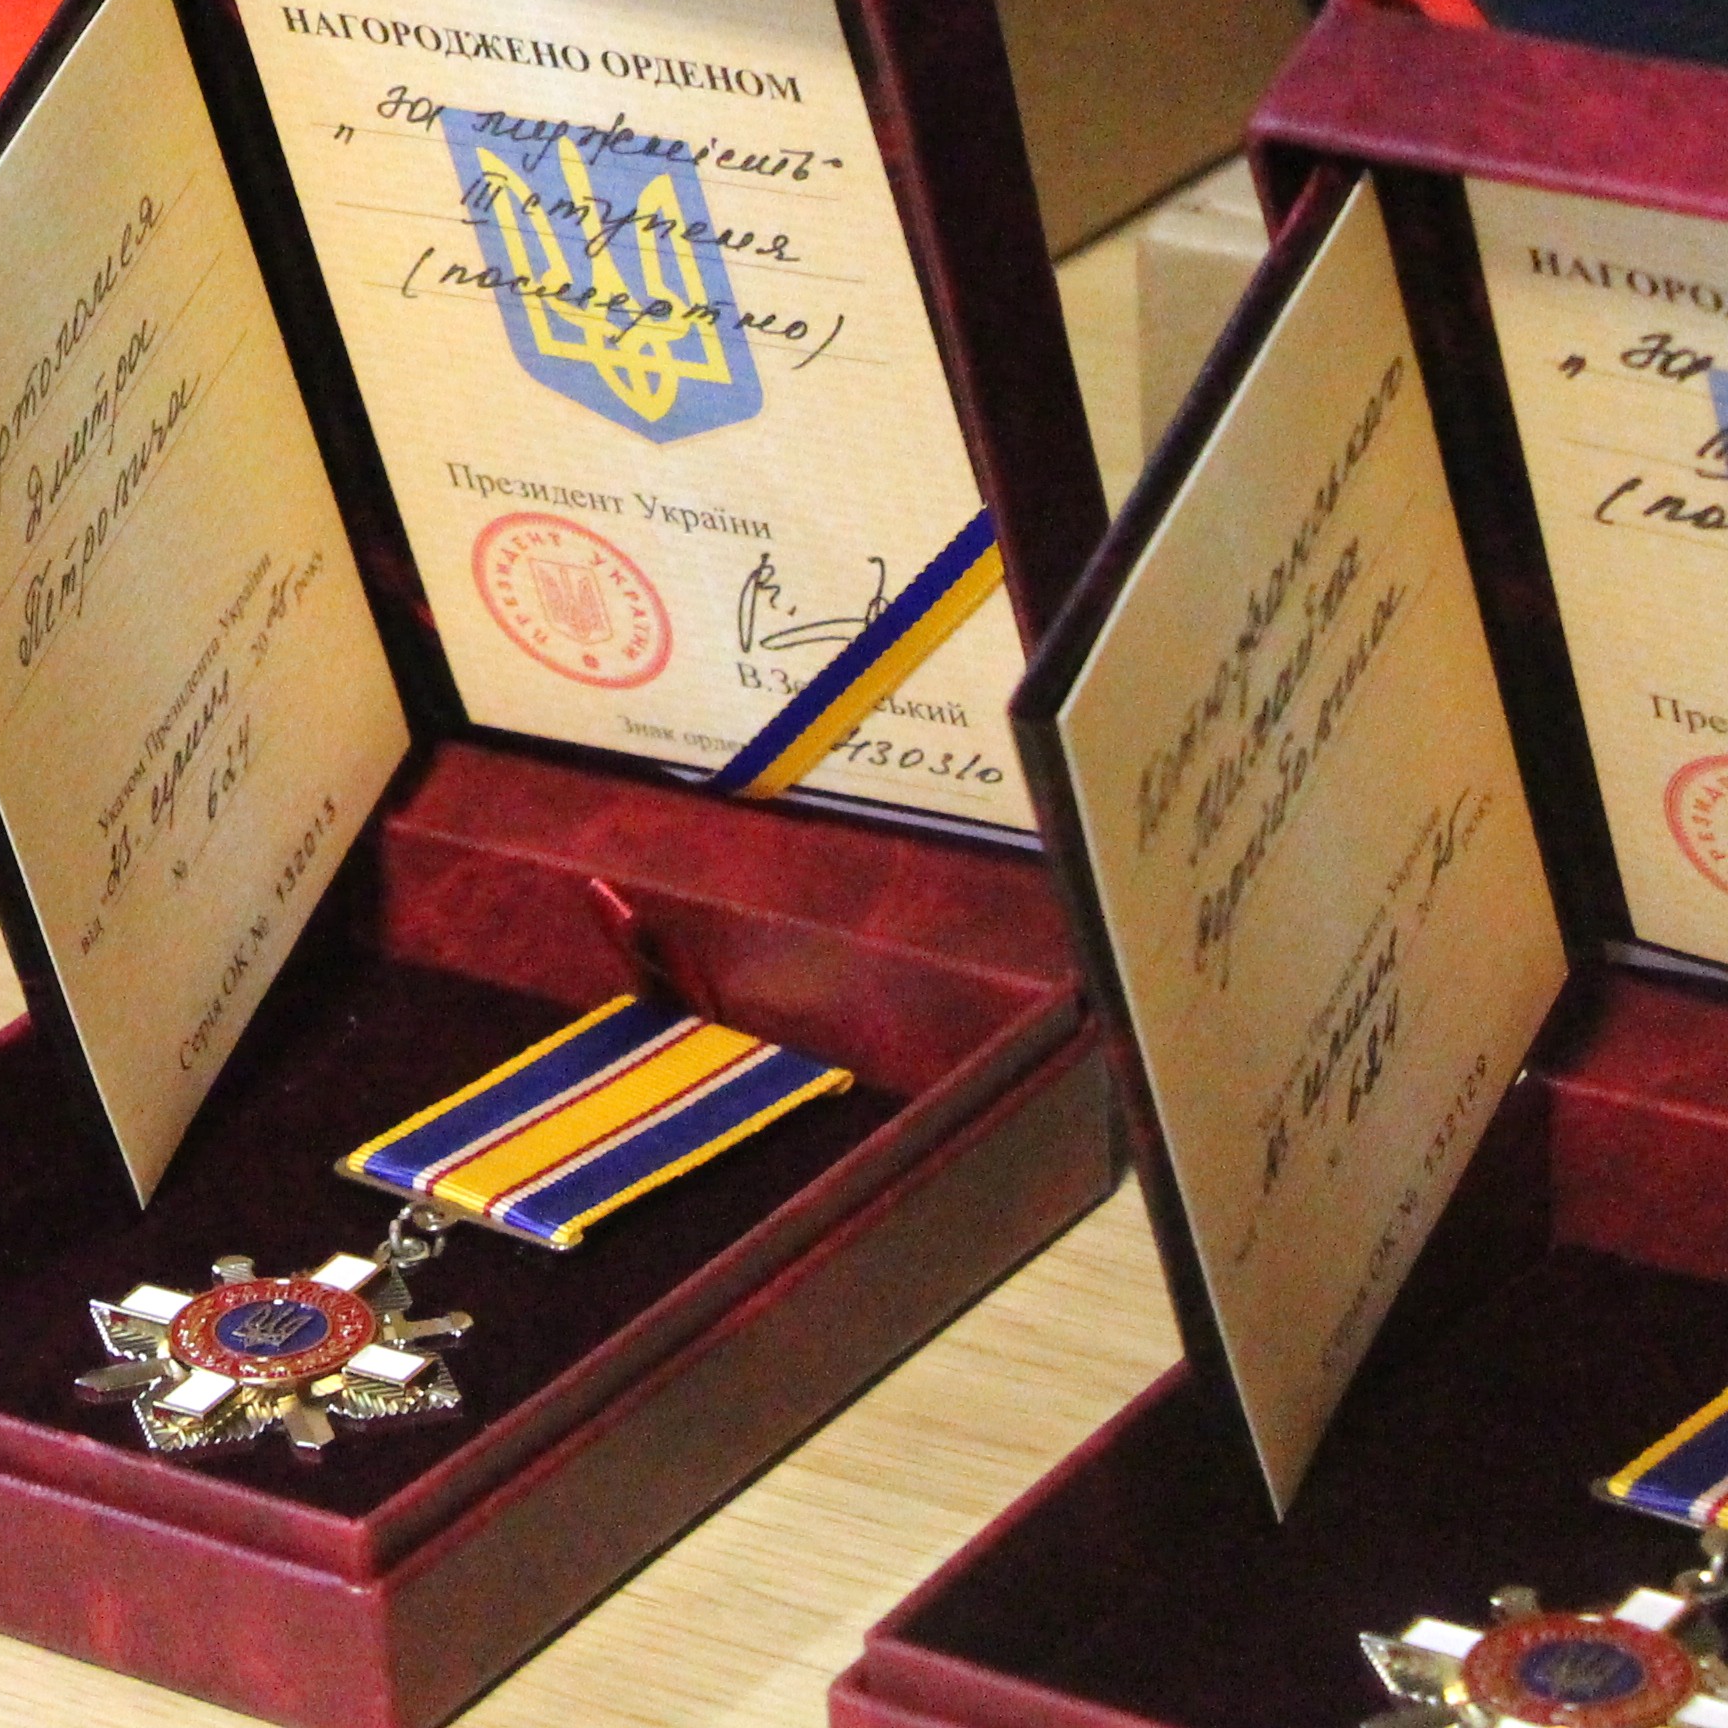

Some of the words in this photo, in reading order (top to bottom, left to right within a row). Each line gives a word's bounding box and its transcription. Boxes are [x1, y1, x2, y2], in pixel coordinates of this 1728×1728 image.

[282, 4, 591, 73] НАГОРОДЖЕНО
[601, 52, 804, 104] ОРДЕНОМ
[520, 196, 802, 263] ступеня
[1528, 246, 1728, 316] НАГОРО
[402, 247, 845, 370] (посмертно)
[25, 318, 158, 544] Дмитра
[18, 374, 201, 669] Петровича
[445, 462, 623, 515] Президент
[634, 492, 772, 540] України
[97, 759, 147, 835] Указом
[145, 636, 219, 765] Президента
[218, 553, 271, 638] України
[206, 715, 250, 822] 624
[80, 916, 104, 956] від
[178, 994, 223, 1071] Серія
[222, 946, 248, 996] ОК
[250, 915, 269, 955] №
[275, 797, 335, 903] 132013
